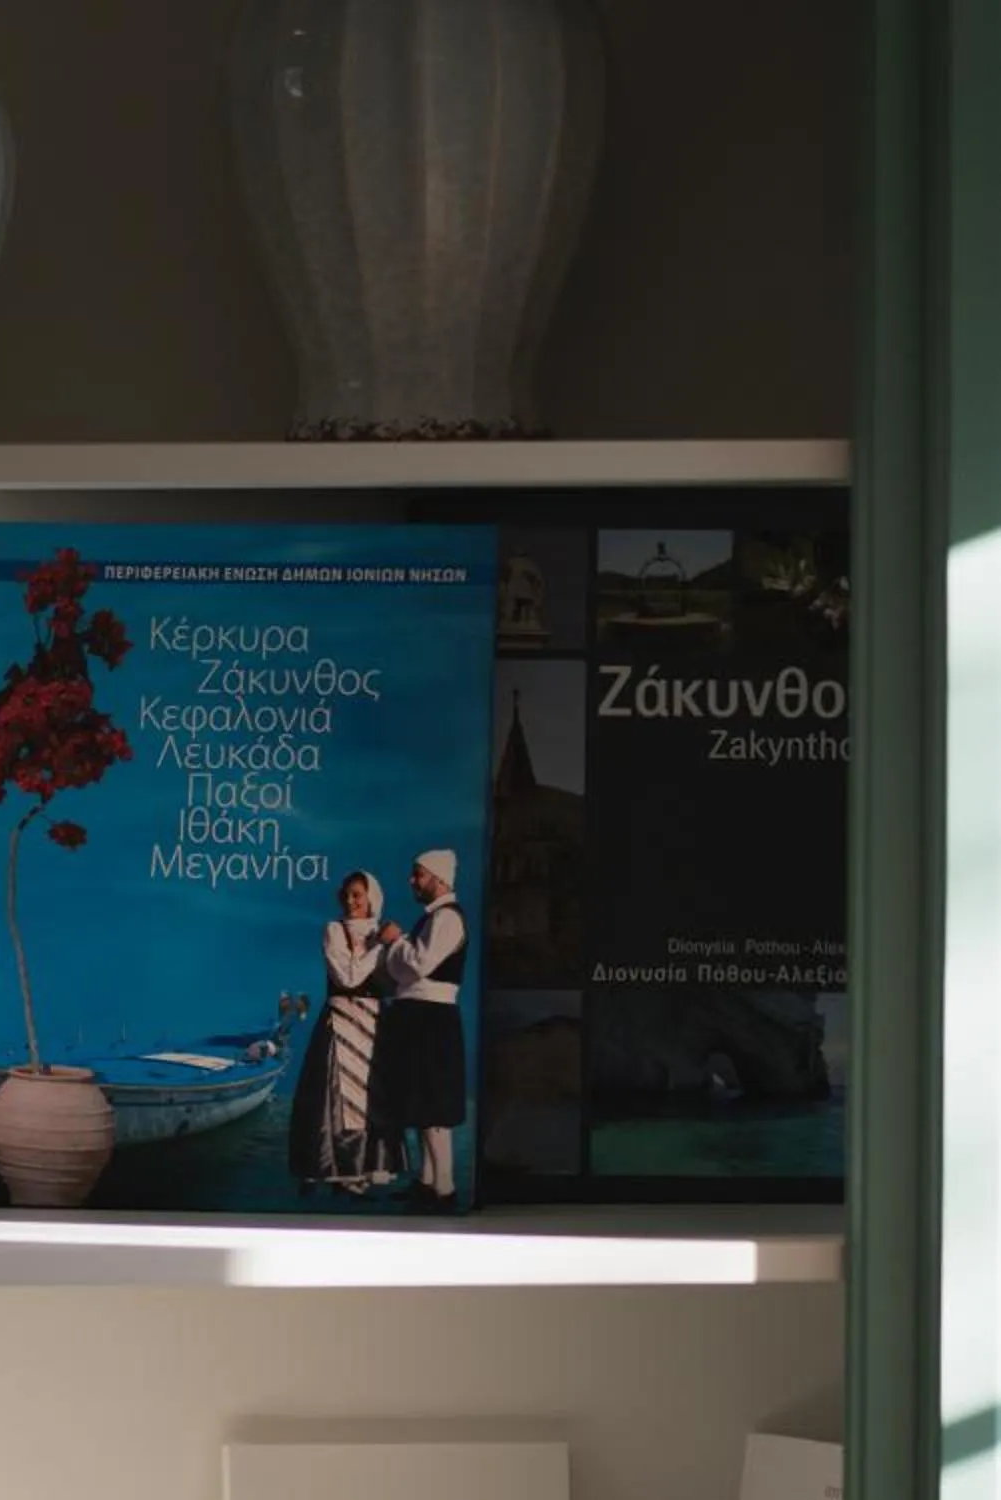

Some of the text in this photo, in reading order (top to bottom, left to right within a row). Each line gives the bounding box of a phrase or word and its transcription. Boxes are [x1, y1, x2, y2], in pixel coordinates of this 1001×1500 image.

[105, 566, 467, 583] ΠΕΡΙΦΕΡΕΙΑΚΗ ΕΝΩΣΗ ΔΗΜΩΝ ΙΟΝΙΩΝ ΝΗΣΩΝ
[150, 616, 308, 659] Κέρκυρα
[197, 659, 381, 700] Ζάκυνθος
[140, 696, 331, 737] Κεφαλονιά
[156, 733, 320, 770] Λευκάδα
[187, 771, 293, 812] Παξοί
[179, 807, 279, 851] Ιθάκη
[150, 845, 329, 888] Μεγανήσι
[591, 962, 687, 983] Διονυσία
